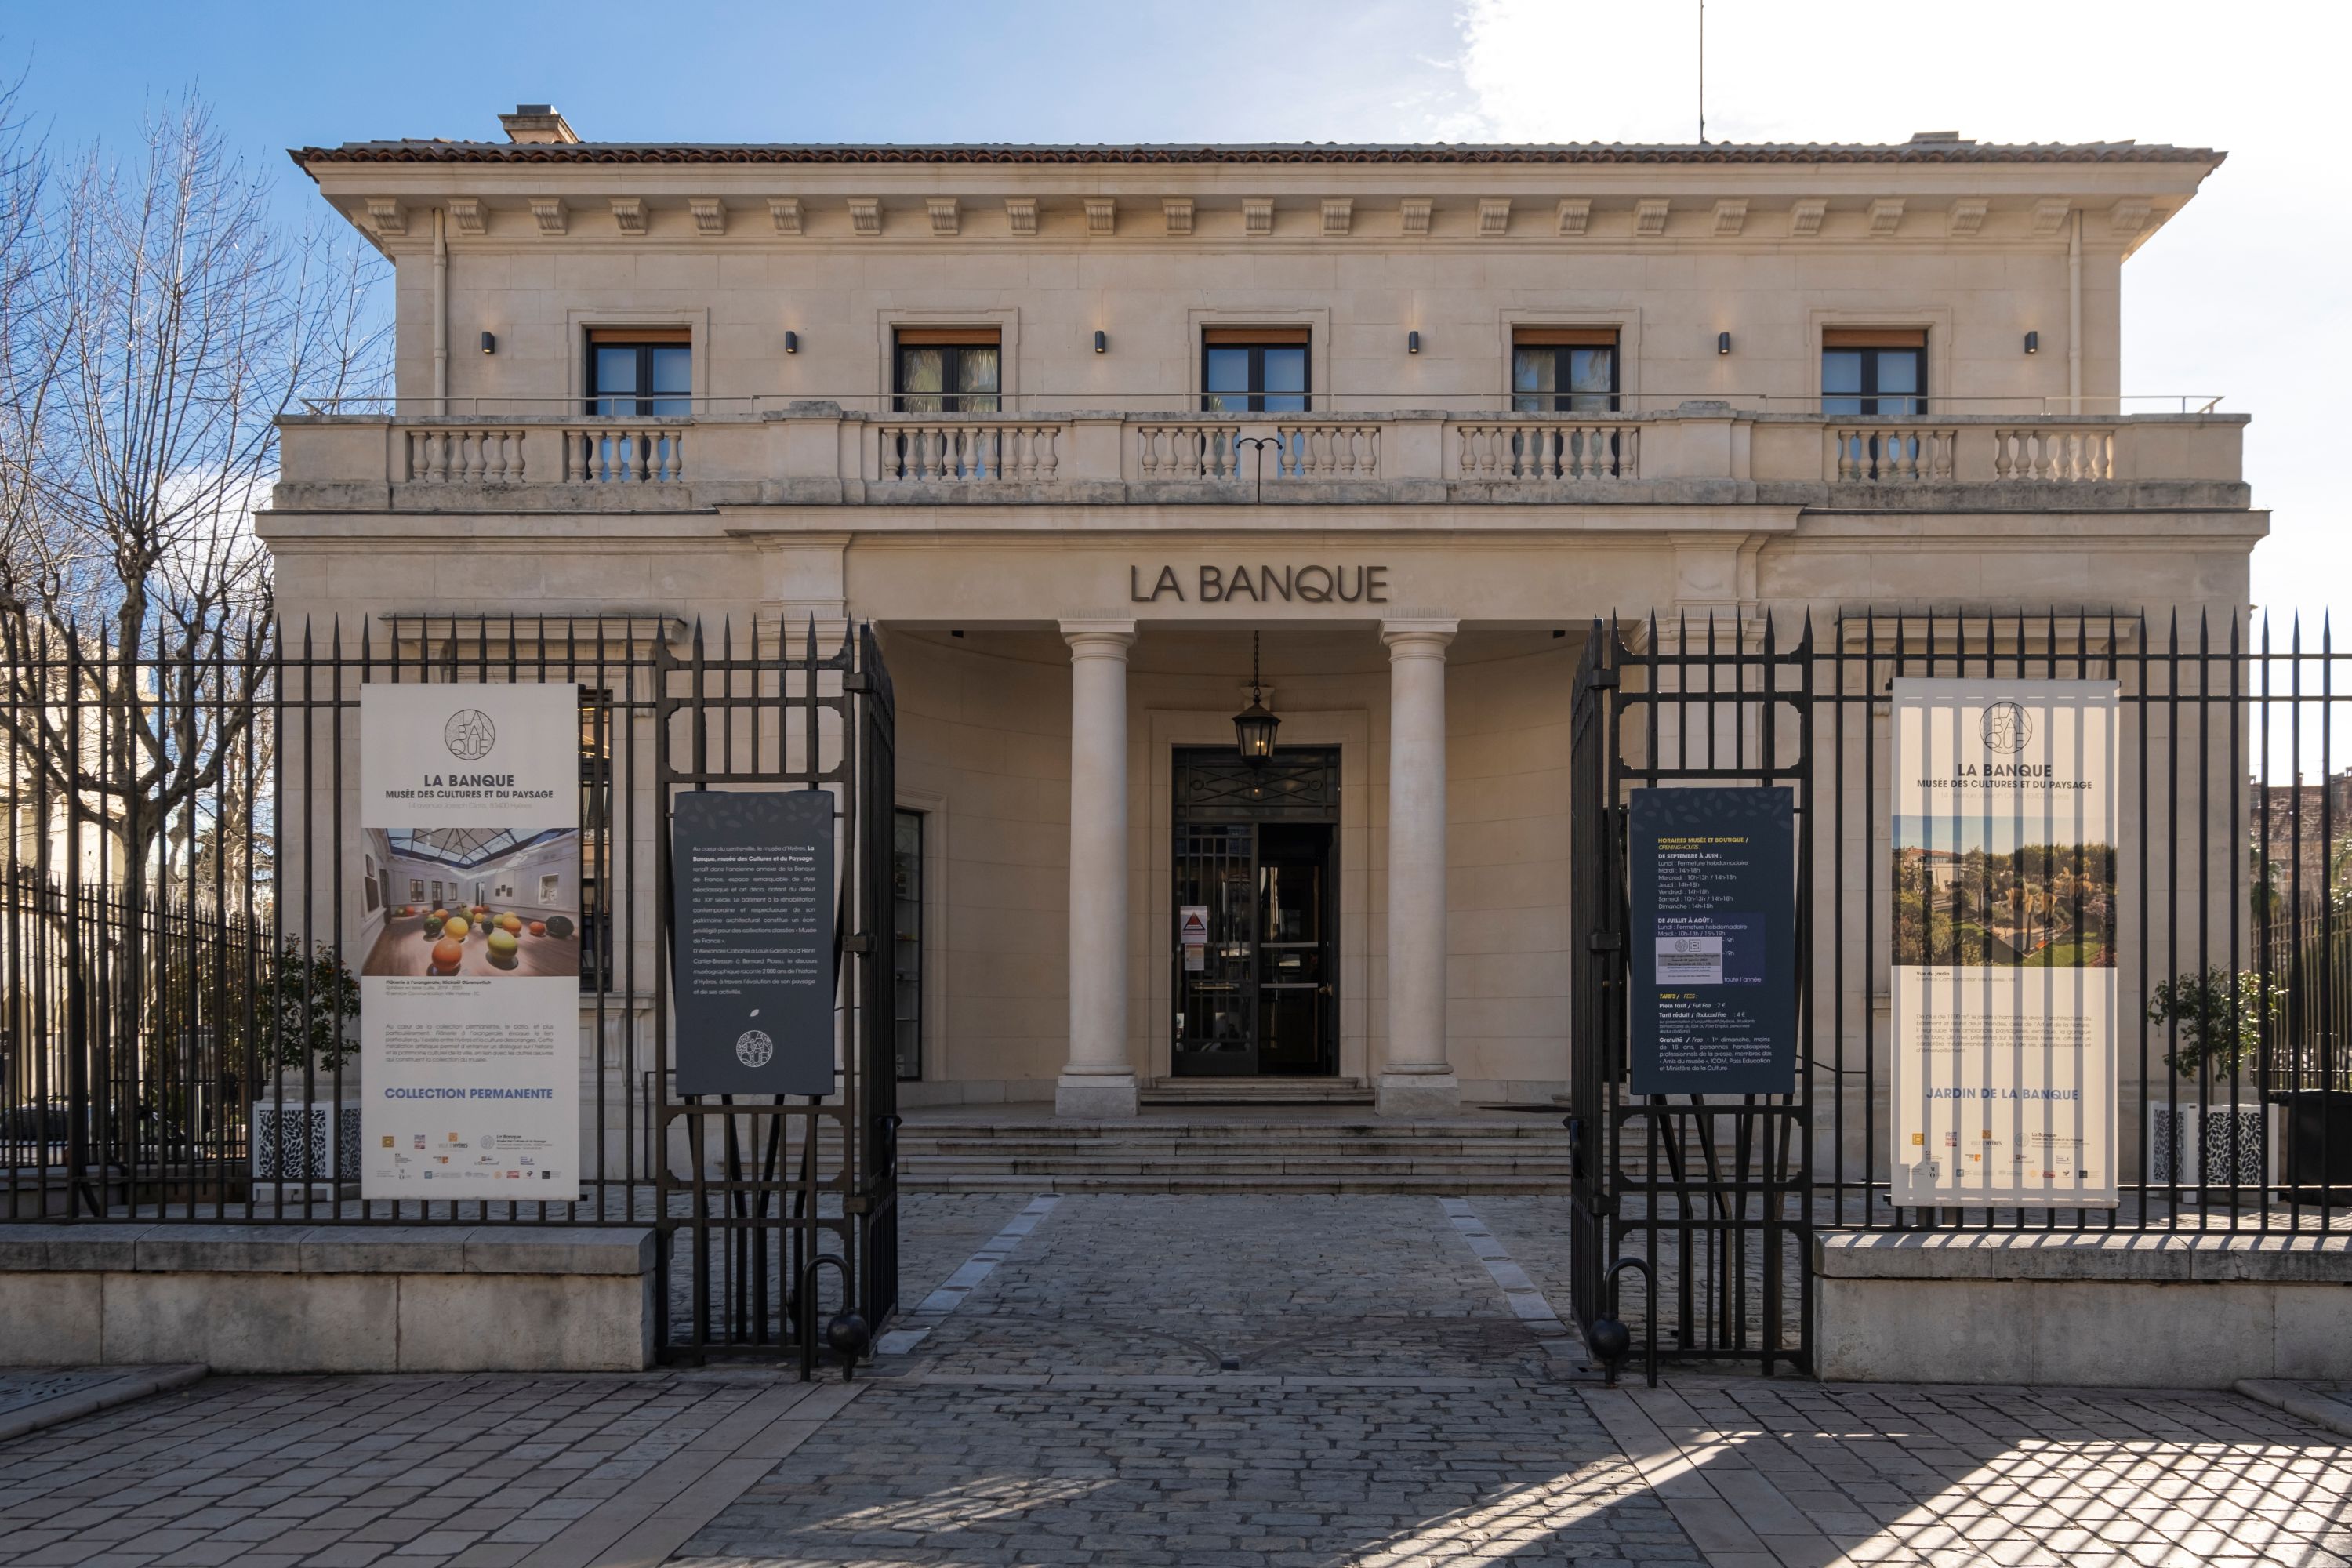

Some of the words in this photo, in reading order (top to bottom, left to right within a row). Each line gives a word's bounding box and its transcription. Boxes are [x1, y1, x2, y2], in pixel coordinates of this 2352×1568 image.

[1131, 565, 1184, 602] LA
[1200, 565, 1387, 602] BANQUE
[1958, 764, 1976, 776] LA
[1984, 764, 2051, 777] BANQUE
[424, 775, 443, 786] LA
[449, 775, 514, 786] BANQUE
[1918, 779, 1947, 788] MUSÉE
[386, 789, 414, 798] MUSÉE
[385, 1089, 465, 1098] COLLECTION
[470, 1089, 553, 1098] PERMANENTE
[1926, 1088, 1976, 1098] JARDIN
[1981, 1089, 1997, 1098] DE
[2002, 1089, 2017, 1098] LA
[2024, 1089, 2078, 1100] BANQUE
